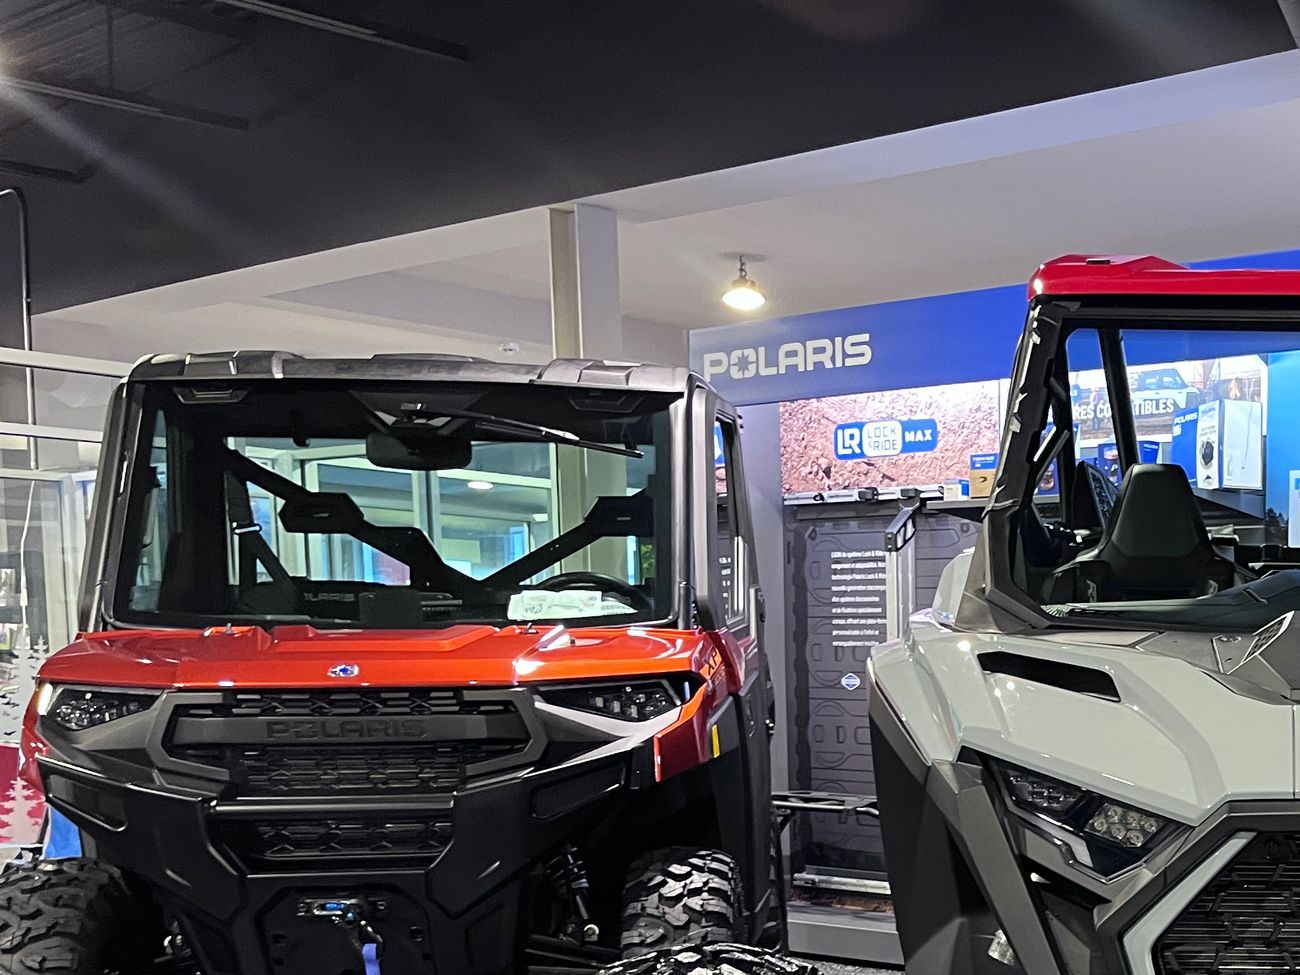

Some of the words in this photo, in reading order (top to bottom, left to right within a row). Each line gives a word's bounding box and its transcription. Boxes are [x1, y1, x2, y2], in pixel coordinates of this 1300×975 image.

[703, 333, 872, 382] POLARIS
[836, 428, 861, 455] LR
[867, 426, 897, 438] LOCK
[904, 429, 932, 442] MAX
[266, 719, 427, 740] POLARIS
